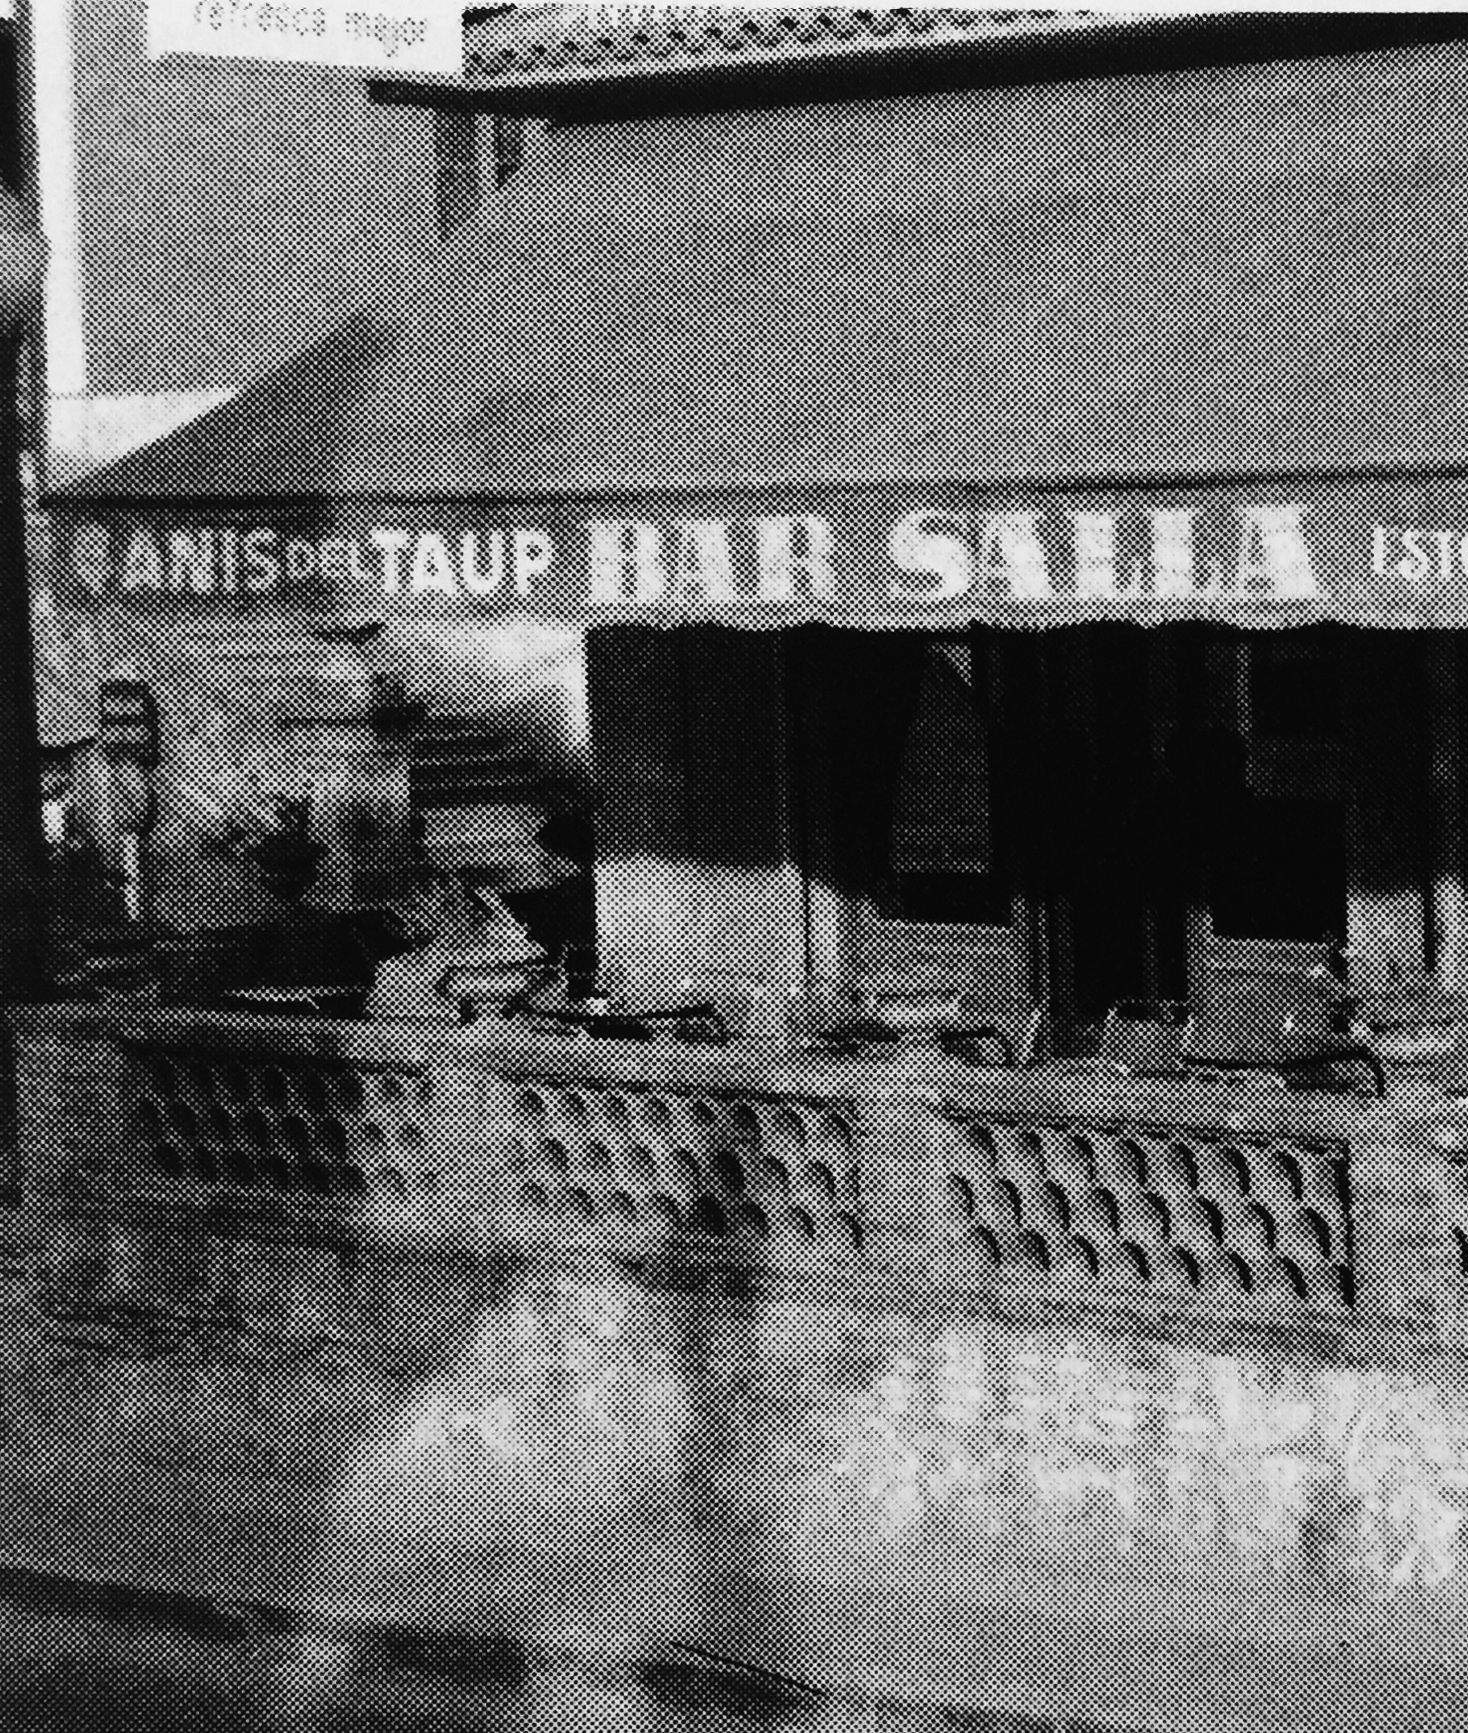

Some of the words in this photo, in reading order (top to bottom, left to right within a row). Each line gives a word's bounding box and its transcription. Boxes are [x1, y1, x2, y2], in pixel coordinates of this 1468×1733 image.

[120, 526, 279, 595] ANIS
[287, 537, 372, 581] DEL
[370, 526, 554, 597] TAUP
[582, 512, 838, 602] BAR
[888, 503, 1330, 602] SALLA
